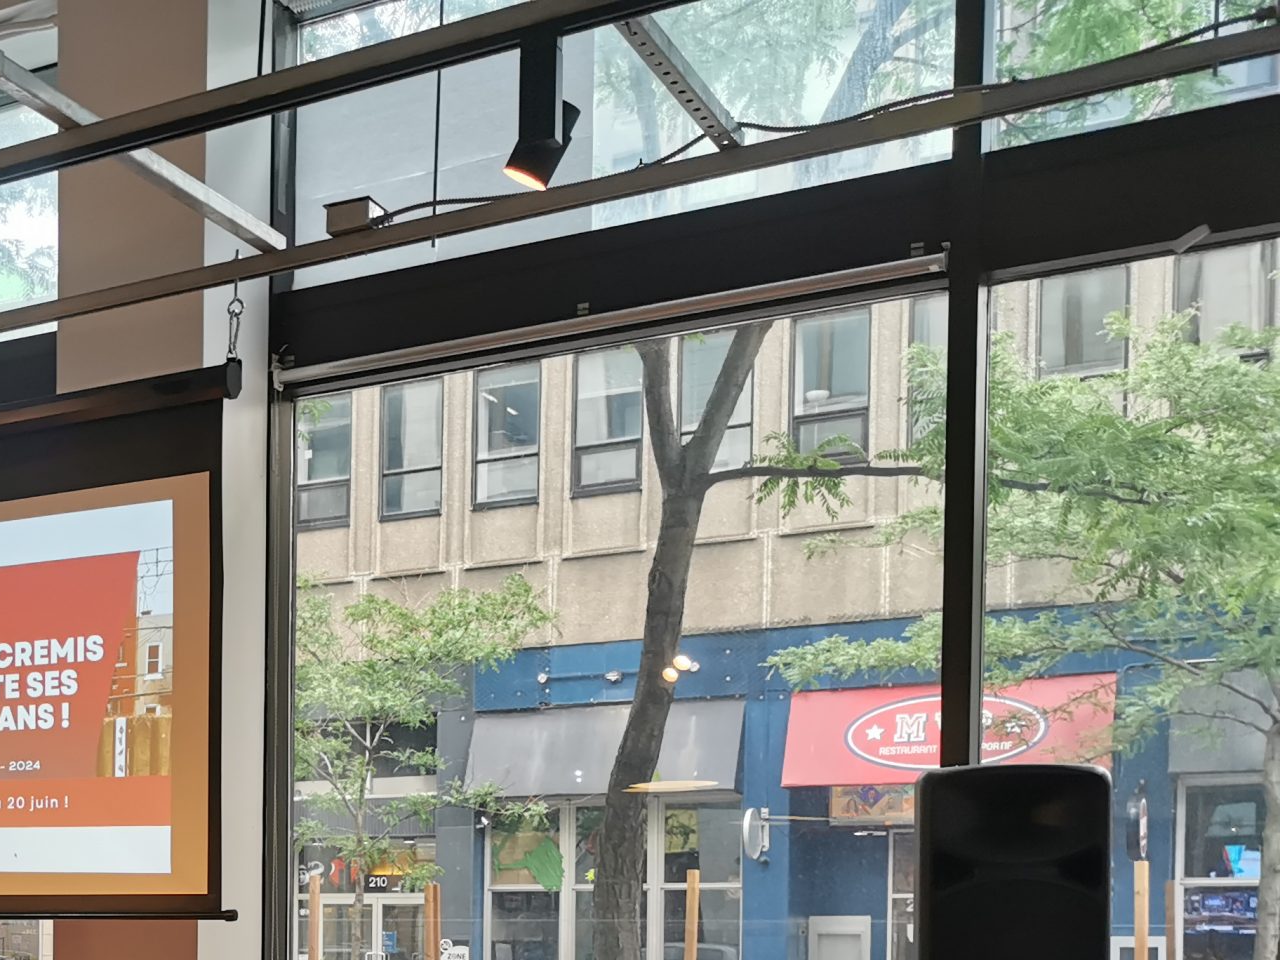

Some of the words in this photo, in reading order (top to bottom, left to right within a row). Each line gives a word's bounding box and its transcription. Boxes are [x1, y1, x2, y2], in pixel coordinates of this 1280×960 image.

[26, 669, 78, 698] SES
[61, 702, 70, 729] !
[878, 744, 938, 756] RESTAURANT
[8, 760, 41, 771] 2024
[7, 796, 25, 809] 20
[29, 796, 59, 811] juin
[64, 796, 69, 808] !
[368, 876, 388, 888] 210
